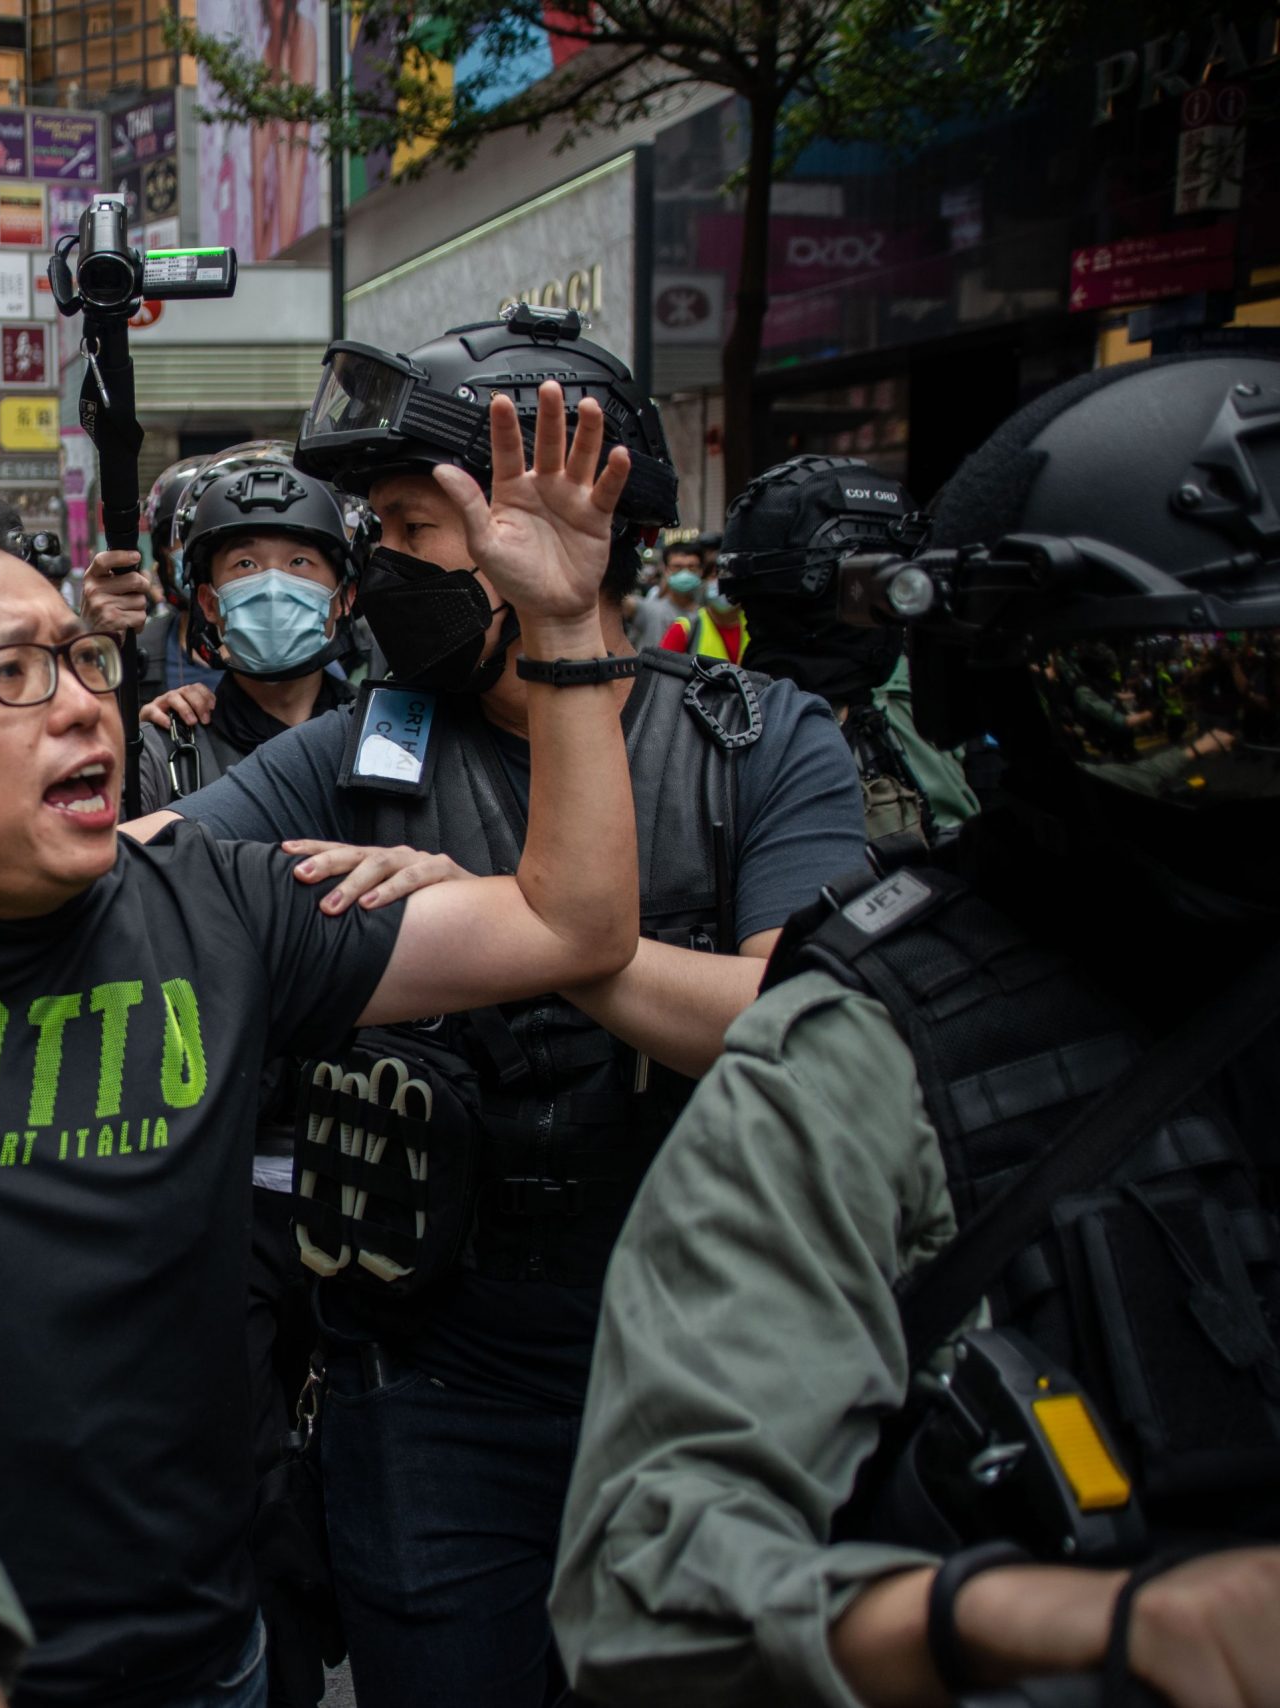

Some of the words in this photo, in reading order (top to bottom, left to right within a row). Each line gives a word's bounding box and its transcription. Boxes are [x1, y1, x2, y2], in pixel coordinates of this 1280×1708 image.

[845, 488, 871, 500] COY
[874, 490, 898, 504] ORD
[404, 700, 426, 738] CRT
[58, 1117, 169, 1161] ITALIA
